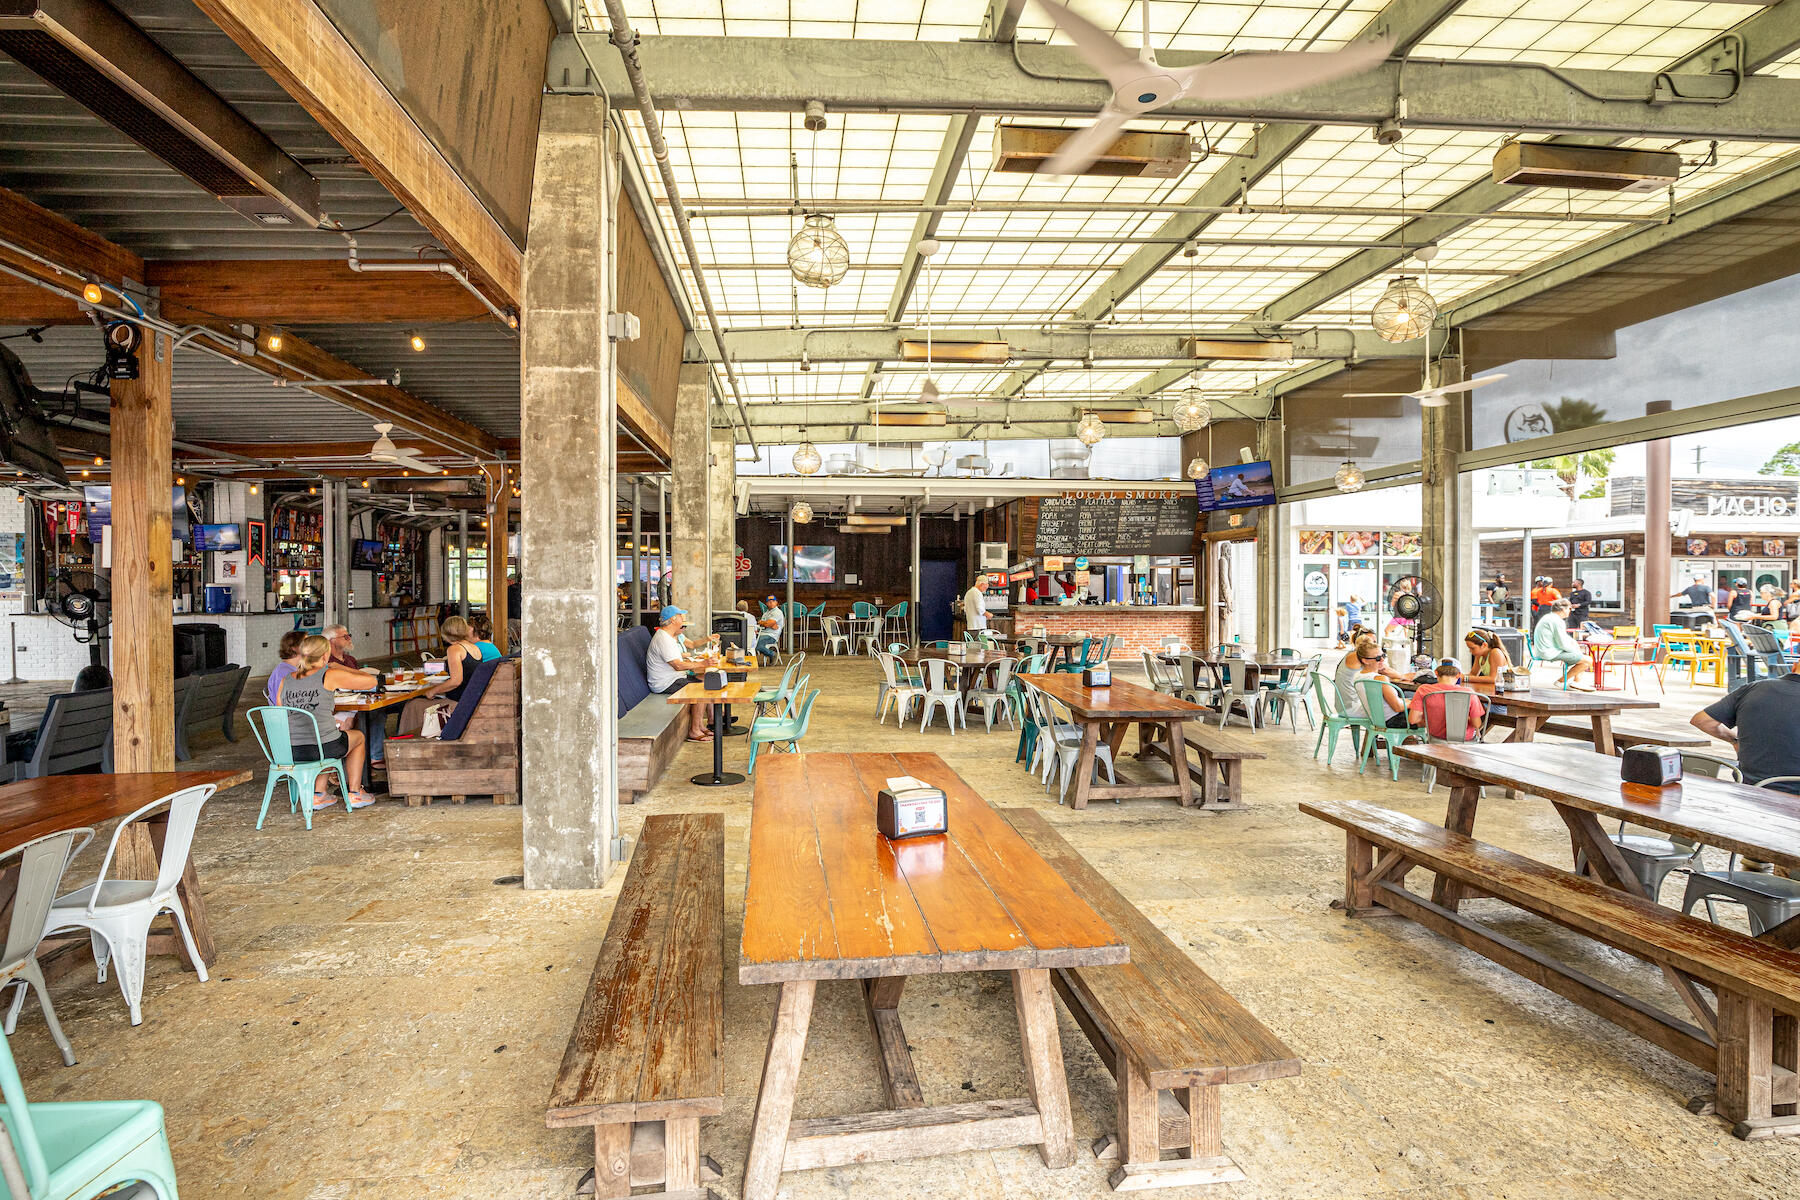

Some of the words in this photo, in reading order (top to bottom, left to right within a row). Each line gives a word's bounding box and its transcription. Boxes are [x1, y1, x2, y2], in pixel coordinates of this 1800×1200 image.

[1066, 490, 1117, 499] LOCAL
[1125, 490, 1179, 499] SMOKE
[1085, 498, 1116, 506] PLATTERS
[1707, 495, 1788, 517] MACHO
